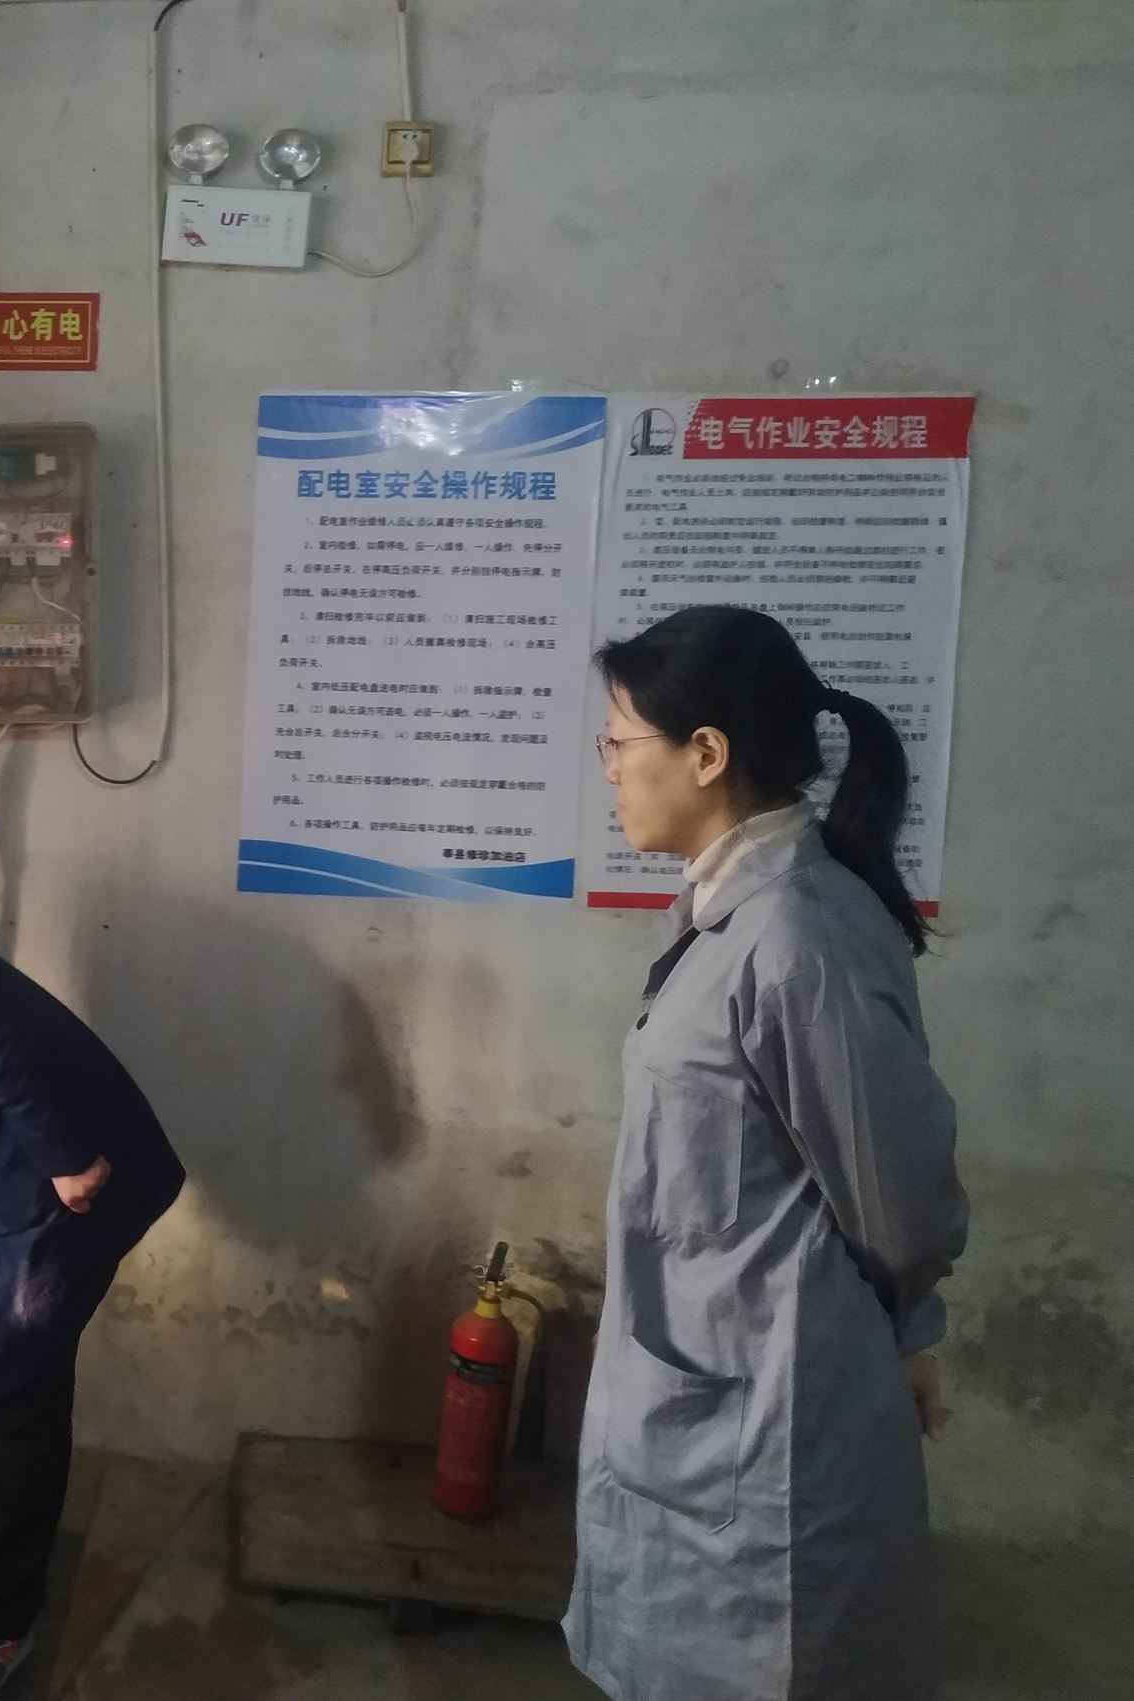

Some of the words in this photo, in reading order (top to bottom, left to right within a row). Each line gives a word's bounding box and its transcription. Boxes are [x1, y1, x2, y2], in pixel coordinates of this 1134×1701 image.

[219, 212, 250, 227] UF
[699, 414, 929, 450] 电气作业安全规程
[297, 469, 557, 501] 配电室安全操作规程
